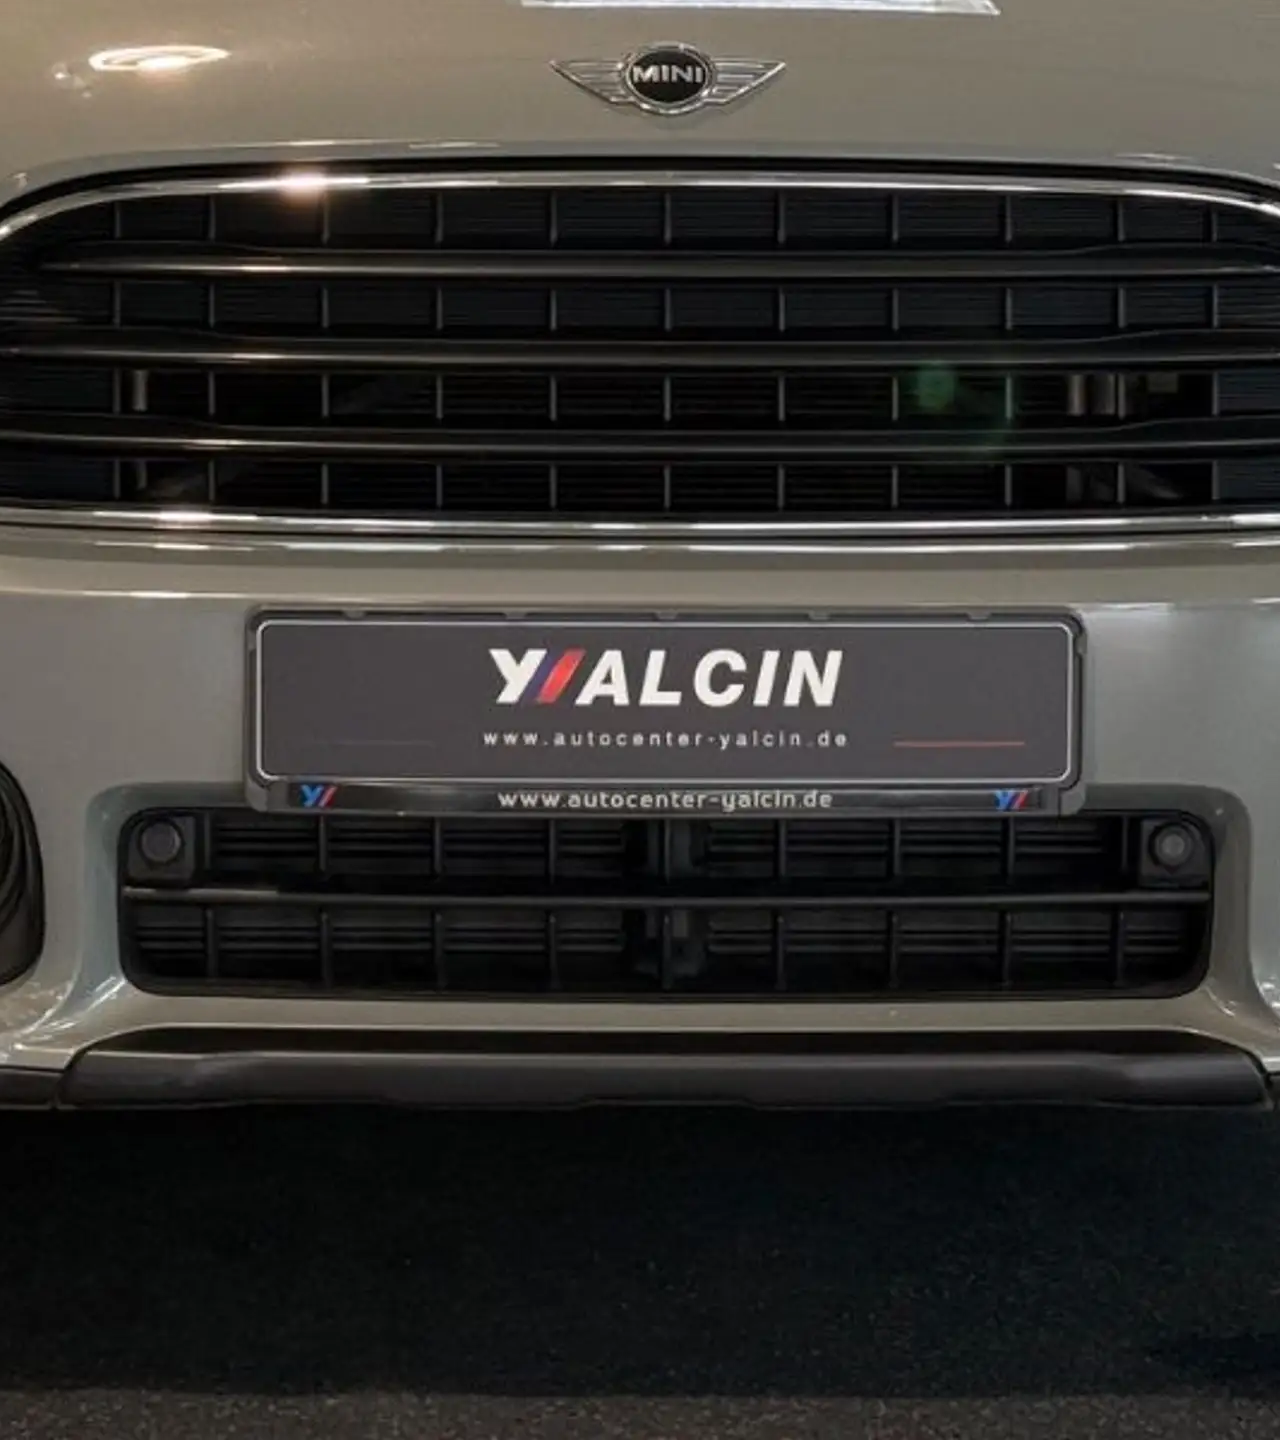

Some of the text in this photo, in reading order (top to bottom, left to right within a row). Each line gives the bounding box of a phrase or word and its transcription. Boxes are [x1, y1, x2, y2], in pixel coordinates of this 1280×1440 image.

[631, 64, 705, 84] MINI
[482, 730, 849, 750] www.autocenter-yalcin.de
[497, 790, 834, 813] www.autocenter-yalcin.de
